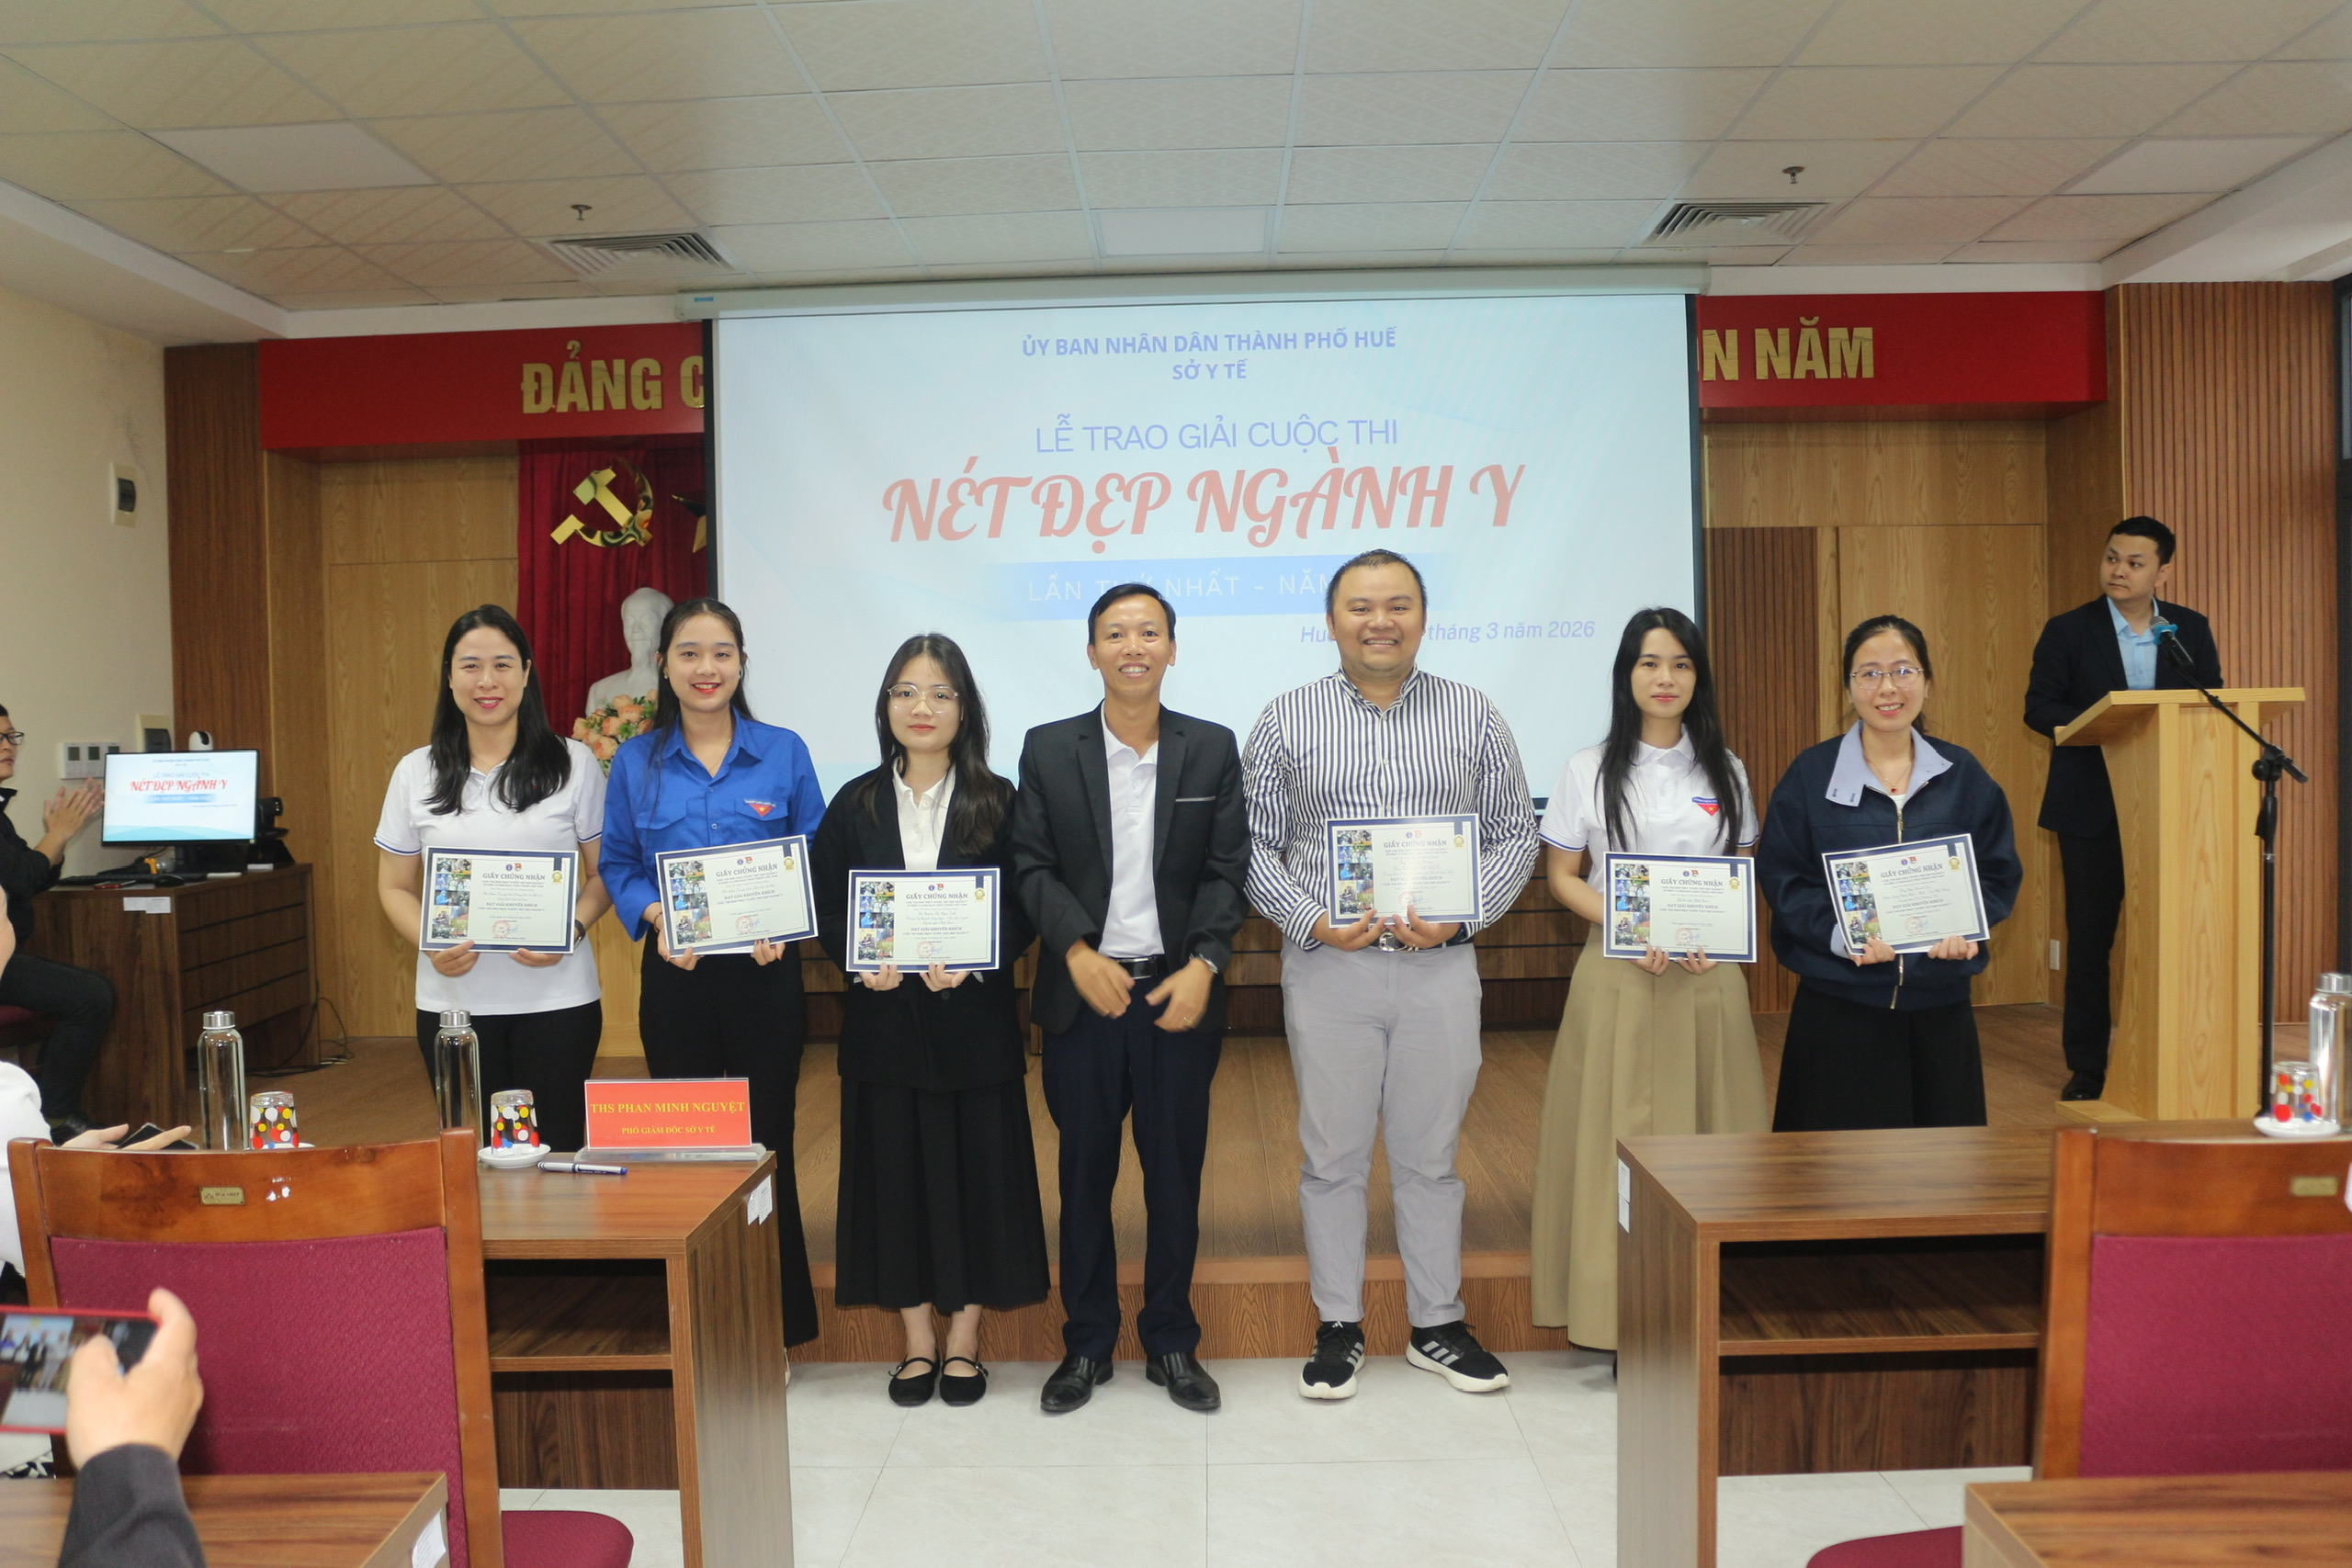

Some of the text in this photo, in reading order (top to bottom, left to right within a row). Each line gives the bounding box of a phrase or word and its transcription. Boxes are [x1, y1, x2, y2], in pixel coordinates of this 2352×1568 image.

[1022, 326, 1396, 356] ỦY BAN NHÂN DÂN THÀNH PHỐ HUẾ
[1754, 316, 1875, 380] NĂM
[521, 340, 662, 413] ĐẢNG
[1172, 358, 1249, 380] SỞ Y TẾ
[1035, 412, 1398, 454] LỄ TRAO GIẢI CUỘC THI
[882, 446, 1526, 554] NÉT ĐẸP NGÀNH Y
[1029, 571, 1082, 602] LẦN
[1165, 567, 1240, 599] NHẤT
[1487, 622, 1499, 639] 3
[1503, 622, 1543, 640] năm
[1548, 620, 1596, 639] 2026
[590, 1100, 745, 1114] THS PHAN MINH NGUYỆT
